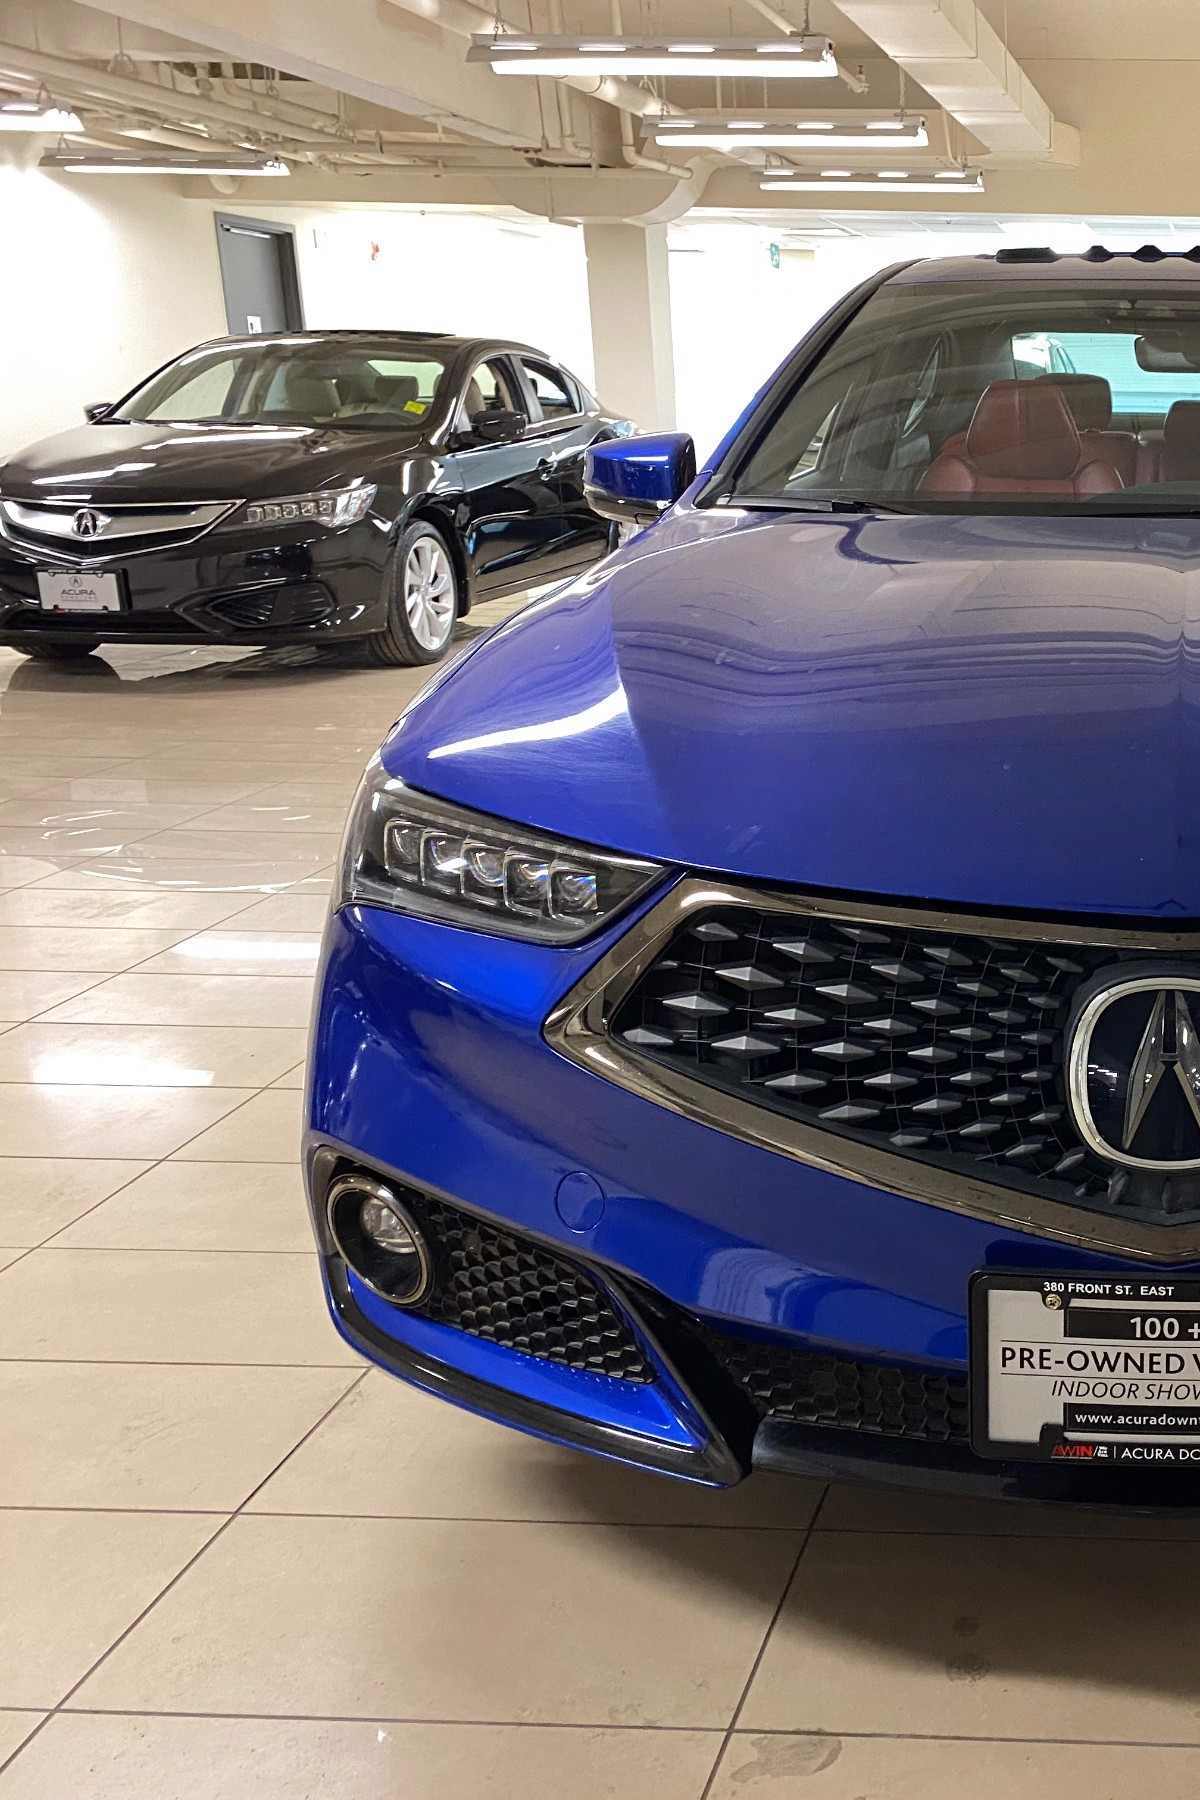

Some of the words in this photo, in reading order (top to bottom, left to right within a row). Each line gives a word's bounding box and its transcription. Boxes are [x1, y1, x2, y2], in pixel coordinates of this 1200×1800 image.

[1043, 1282, 1065, 1292] 380
[1068, 1283, 1111, 1295] FRONT
[1115, 1286, 1133, 1295] ST.
[1140, 1287, 1174, 1296] EAST
[1130, 1317, 1180, 1339] 100
[1001, 1347, 1185, 1375] PRE-OWNED
[1051, 1380, 1139, 1399] INDOOR
[1121, 1447, 1175, 1460] ACURA
